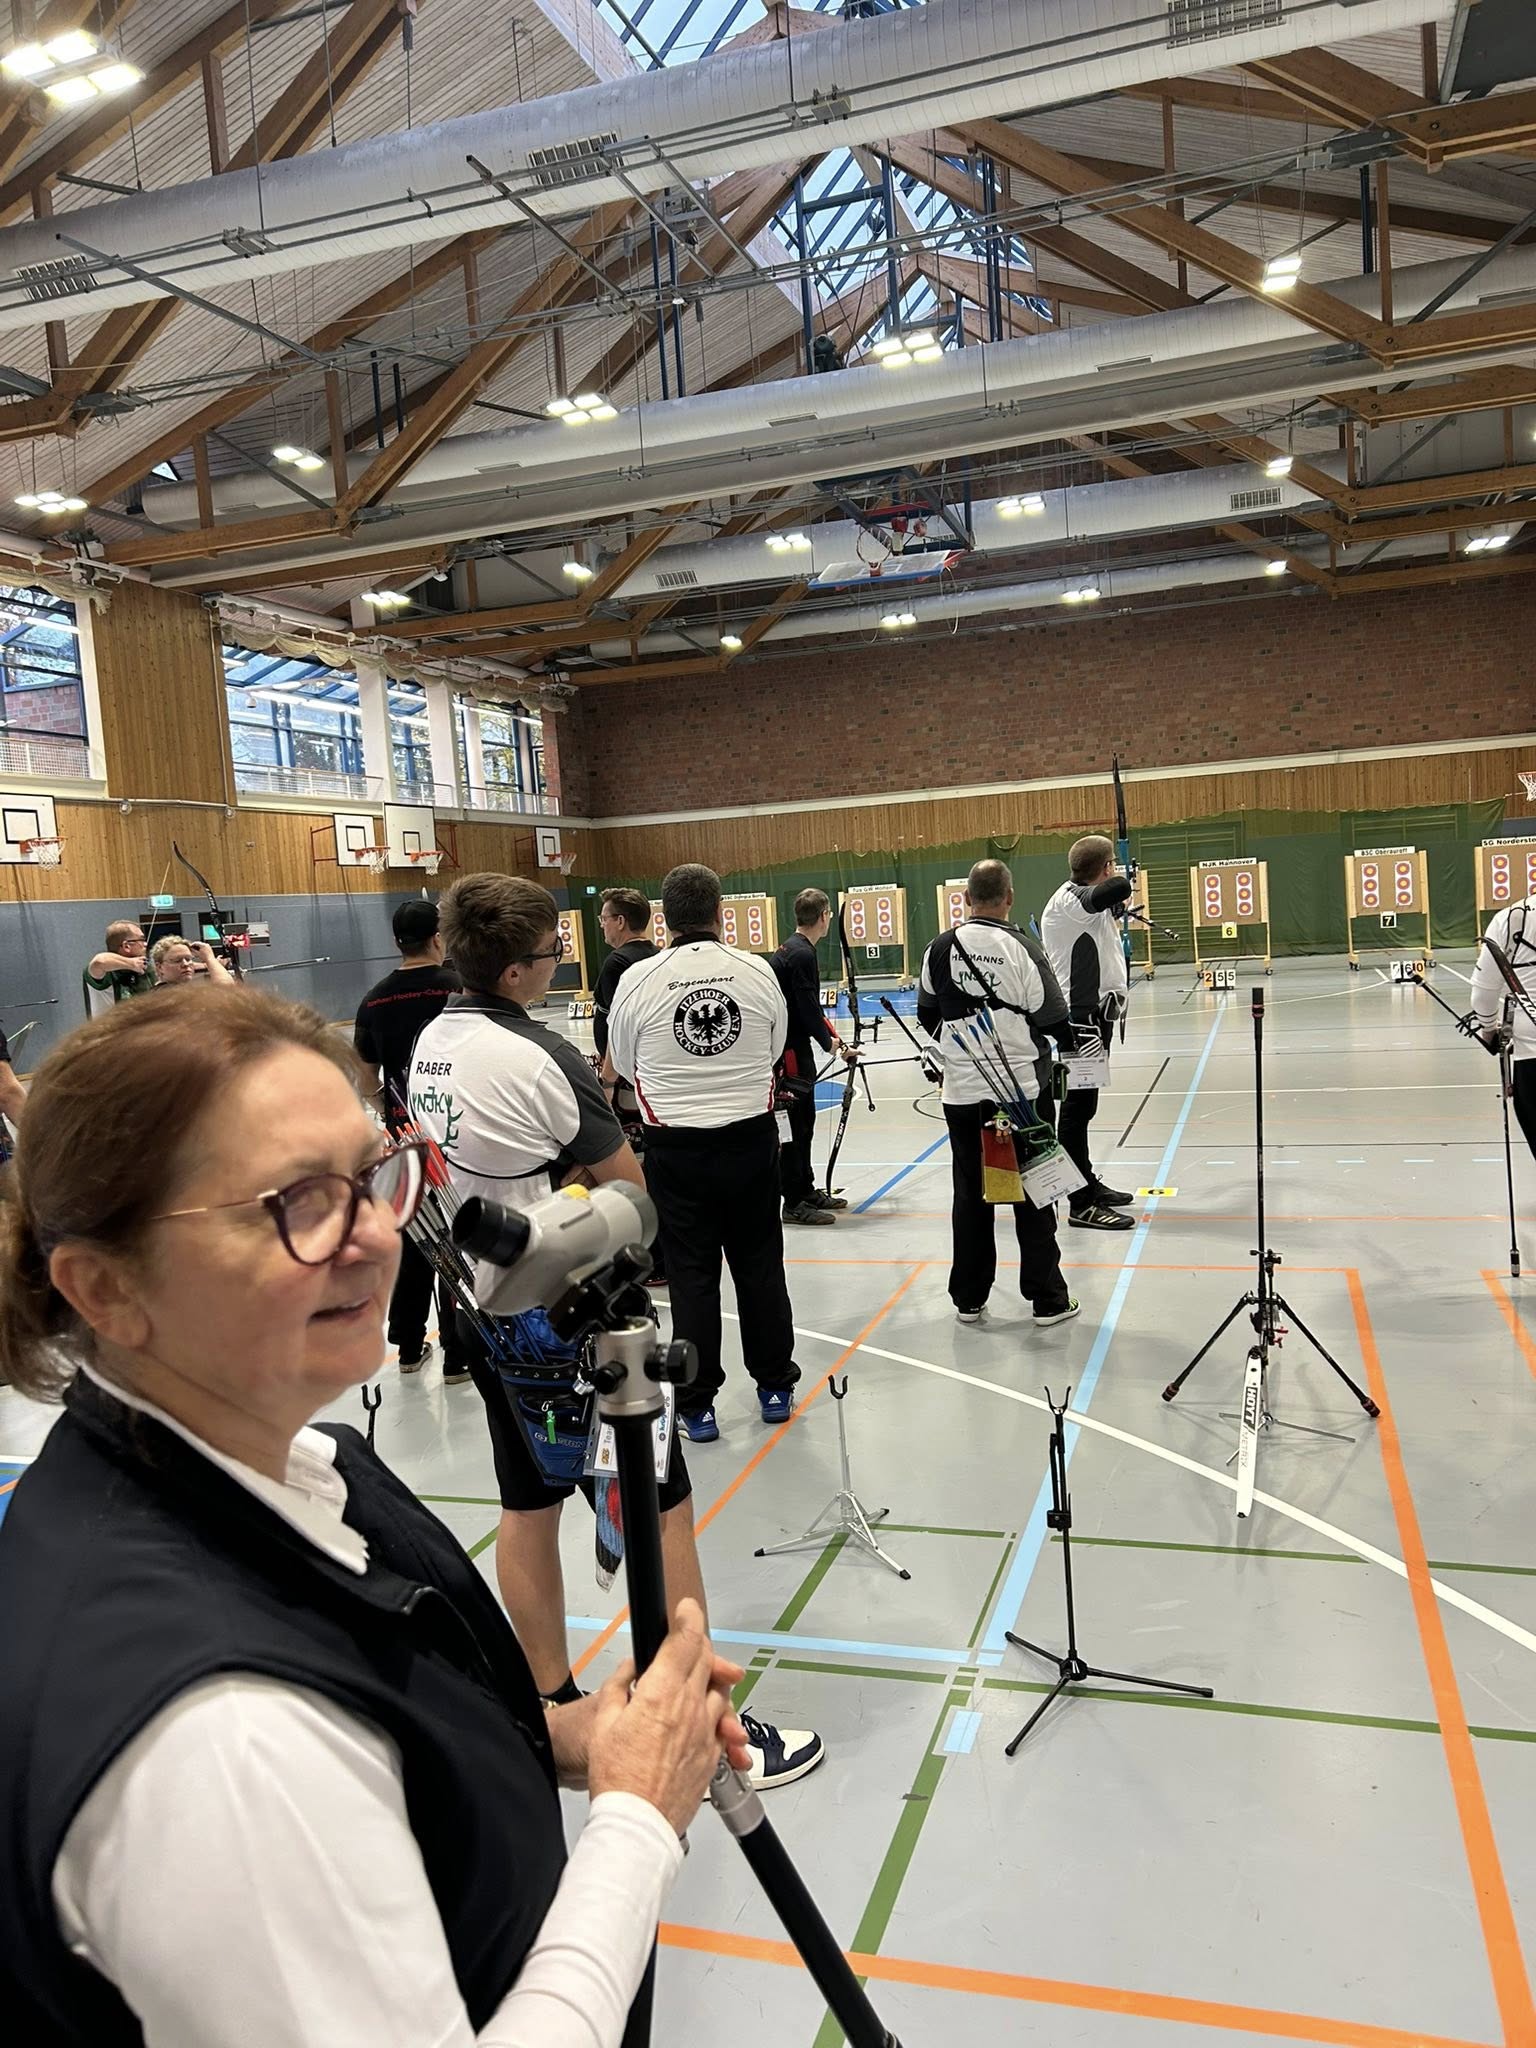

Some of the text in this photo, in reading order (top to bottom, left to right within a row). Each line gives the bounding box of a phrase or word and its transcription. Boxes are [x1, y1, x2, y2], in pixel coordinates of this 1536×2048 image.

[1384, 916, 1392, 926] 7
[1225, 926, 1233, 936] 6
[870, 948, 876, 956] 3
[667, 976, 734, 990] Bogensport
[680, 990, 730, 1011] ITZEHOER
[416, 1061, 453, 1076] RABER
[1245, 1387, 1257, 1425] HOYT
